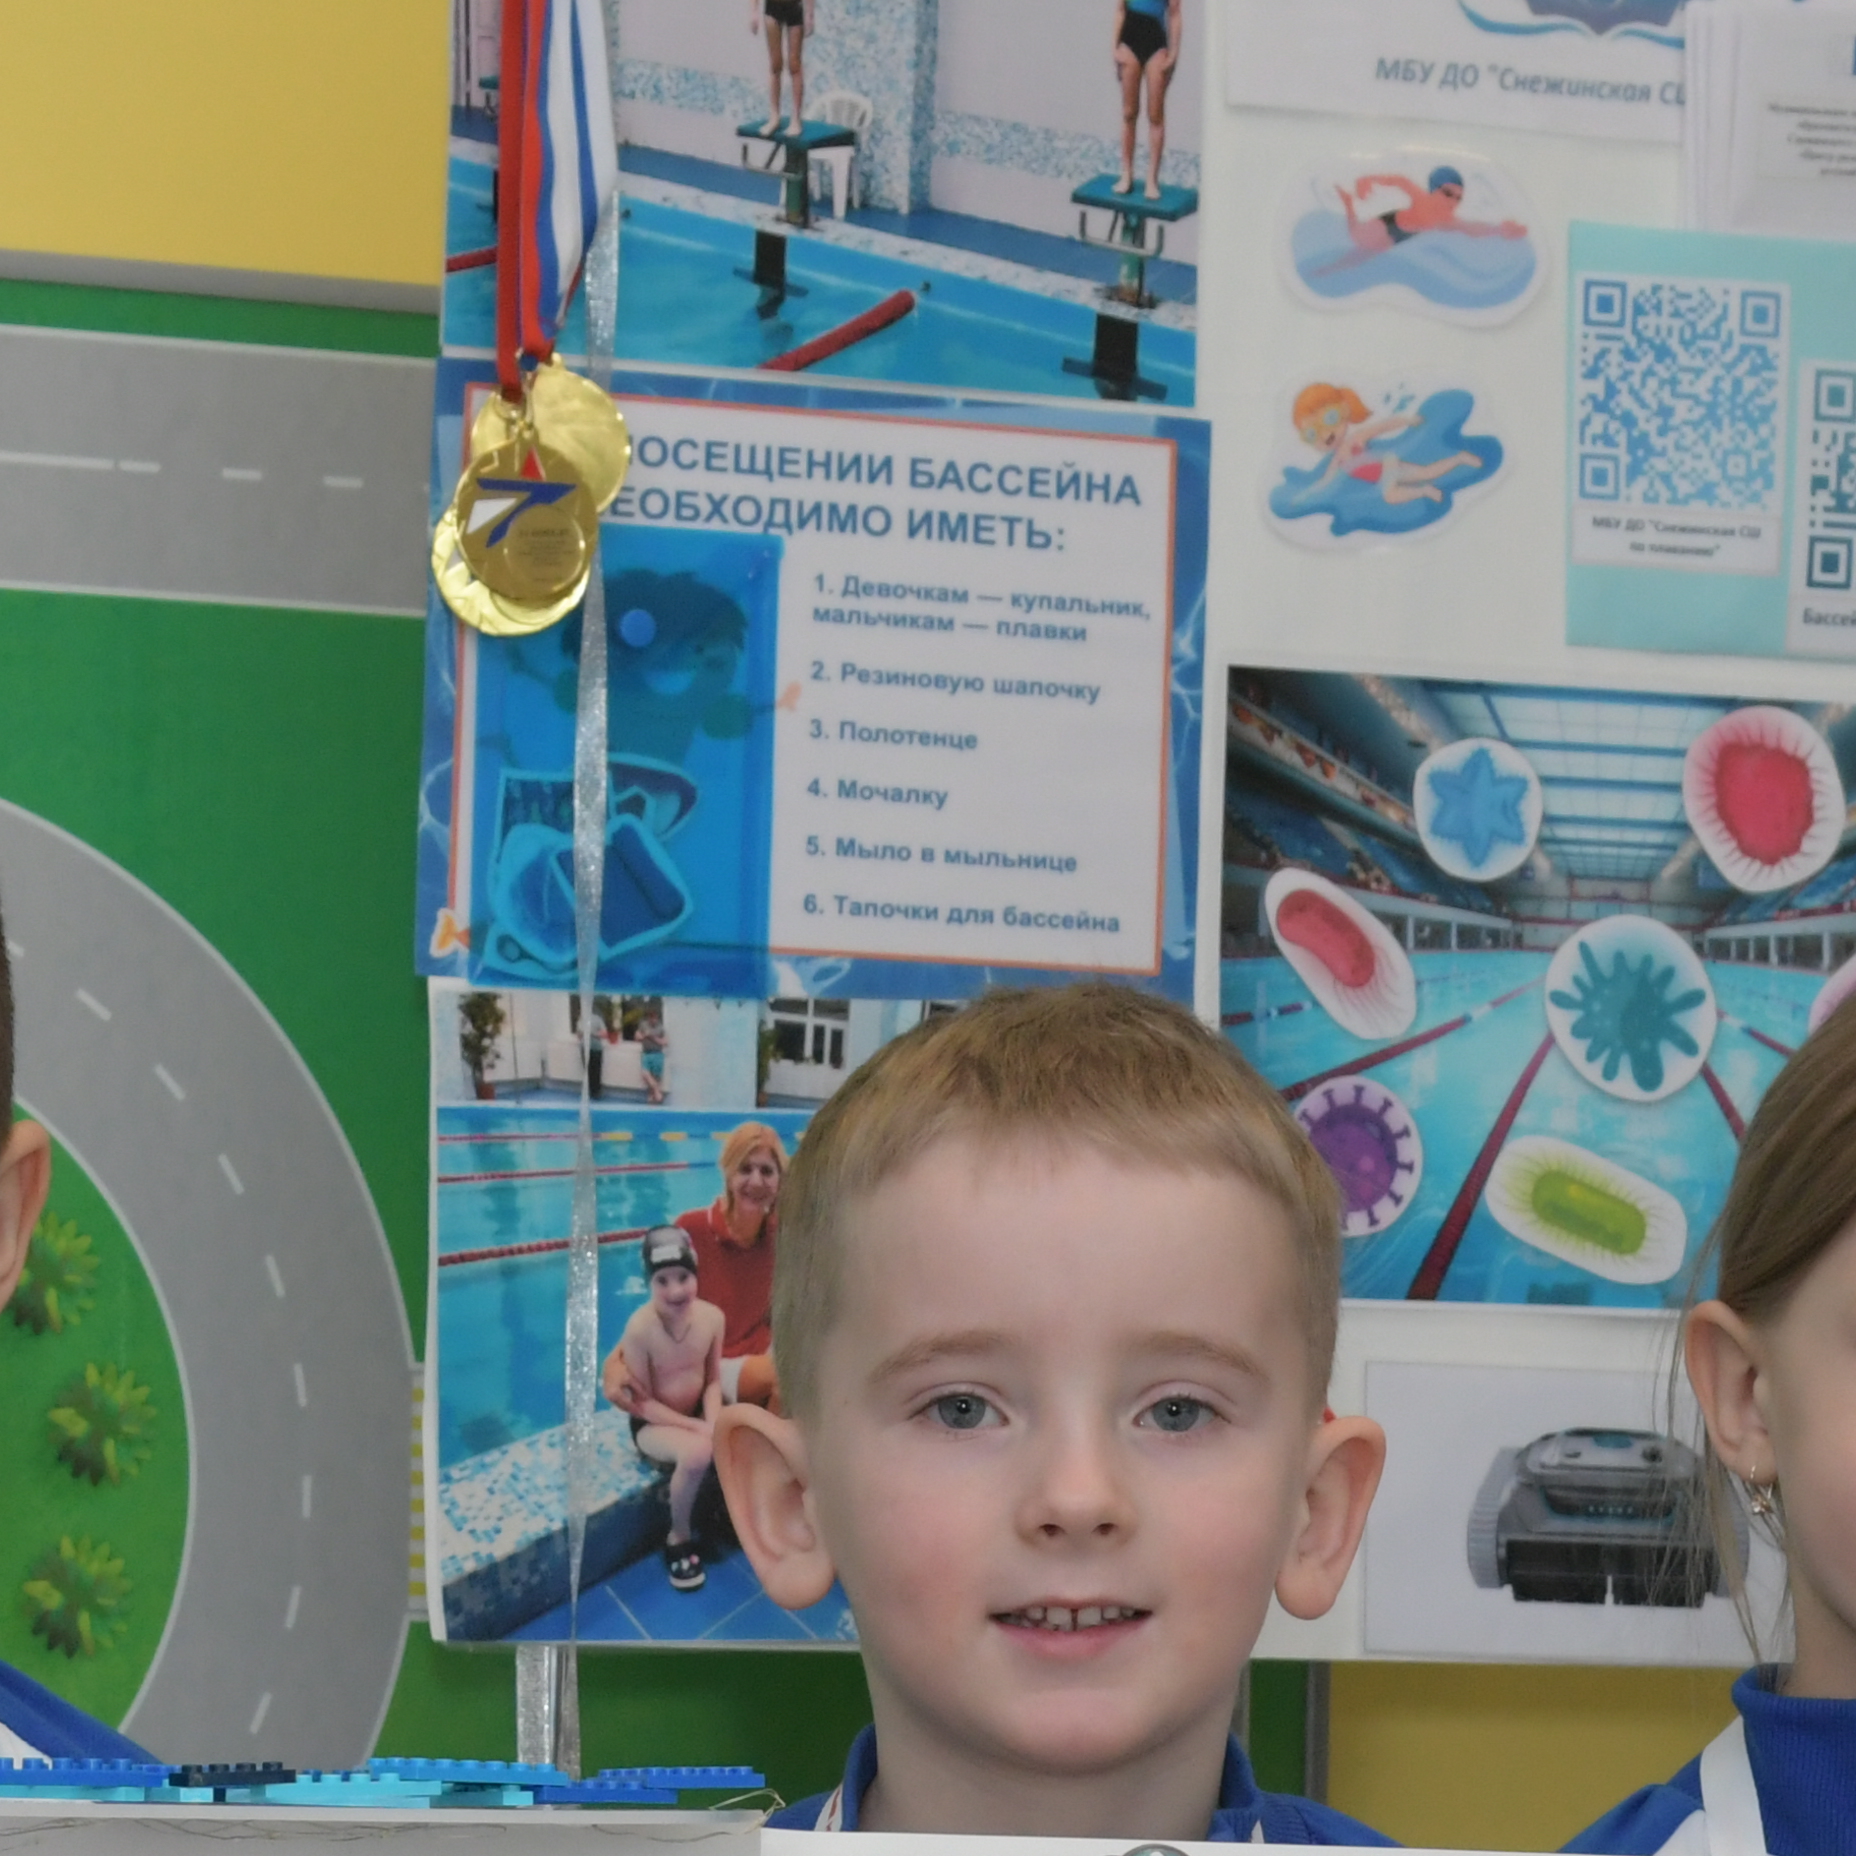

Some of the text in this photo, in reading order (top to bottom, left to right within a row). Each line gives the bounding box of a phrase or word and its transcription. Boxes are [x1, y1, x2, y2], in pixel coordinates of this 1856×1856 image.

[1375, 57, 1436, 84] МБУ
[1438, 62, 1480, 91] ДО
[628, 434, 1142, 507] ОСЕЩЕНИИ БАССЕЙНА
[608, 486, 1065, 552] ЕОБХОДИМО ИМЕТЬ:
[814, 573, 834, 595] 1.
[841, 575, 969, 604] Девочкам
[1011, 591, 1151, 621] купальник,
[812, 606, 955, 632] мальчикам
[996, 619, 1087, 643] плавки
[810, 661, 1101, 706] 2. Резиновую шапочку
[809, 718, 979, 751] 3. Полотенце
[806, 778, 949, 811] 4. Мочалку
[805, 836, 1078, 874] 5. Мыло в мыльнице
[803, 894, 1121, 934] 6. Тапочки для бассейна
